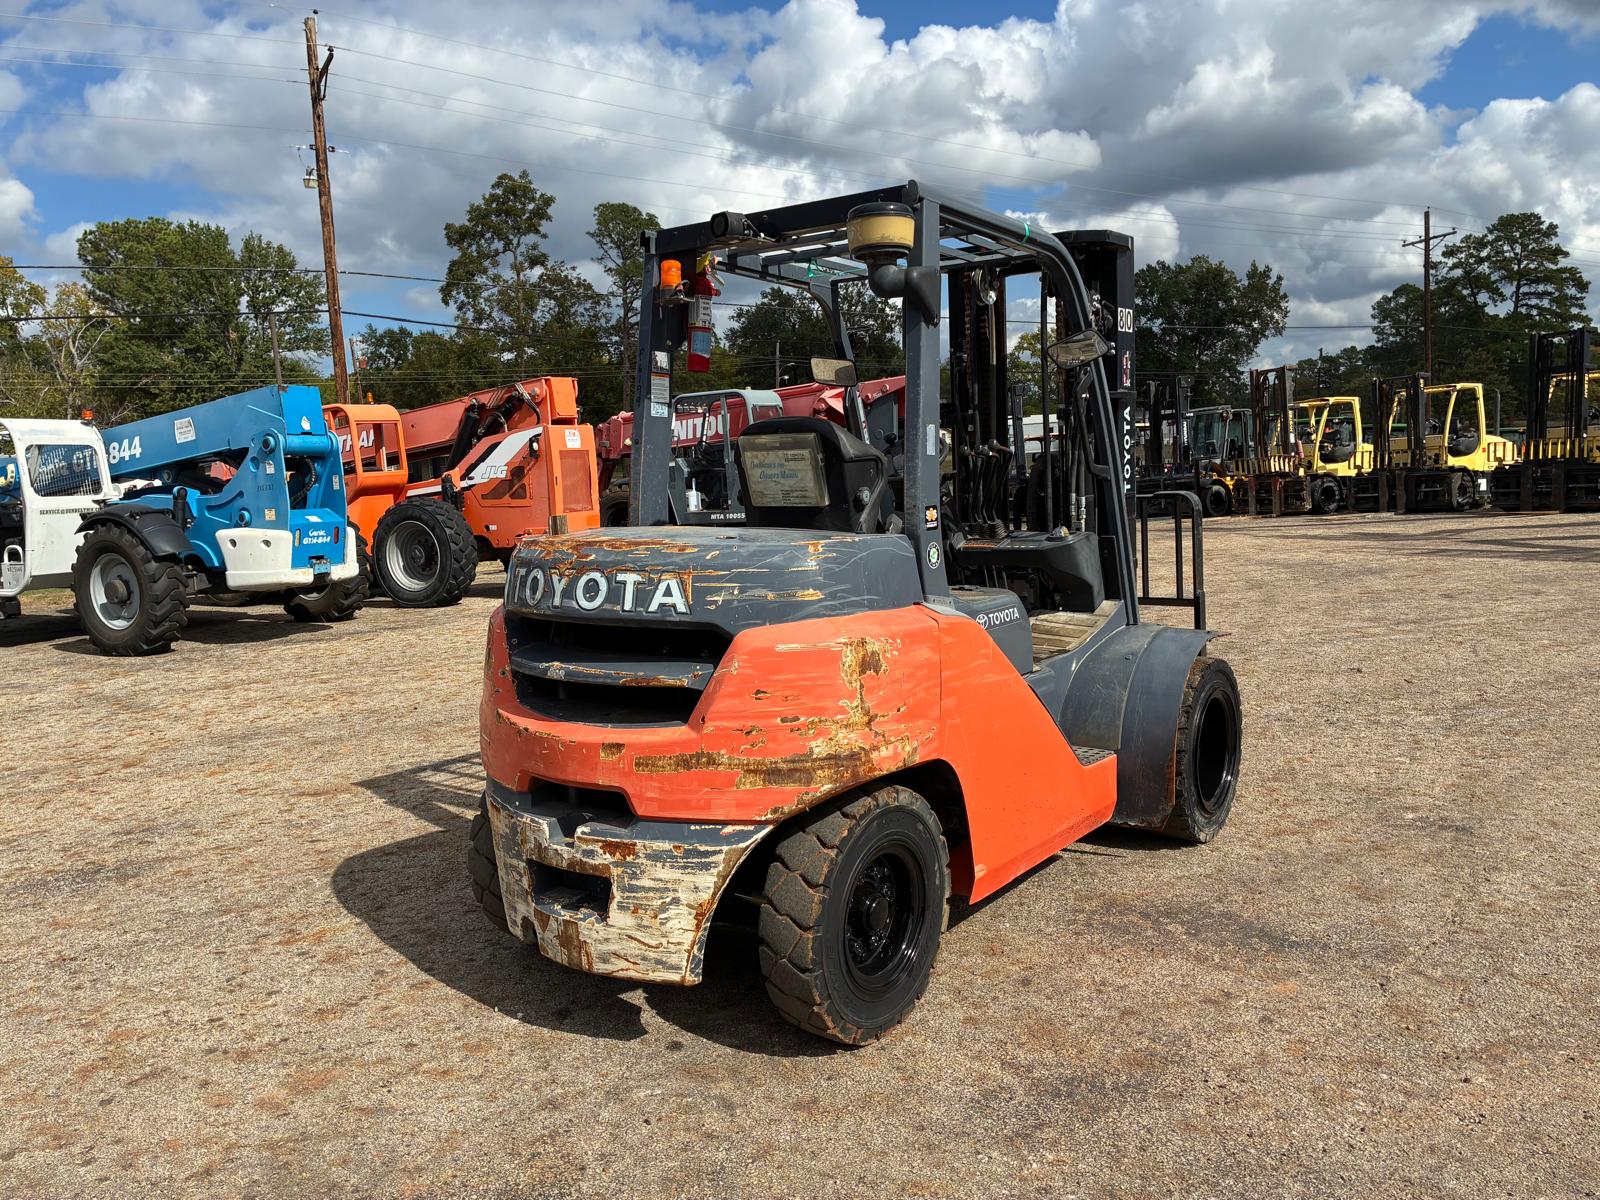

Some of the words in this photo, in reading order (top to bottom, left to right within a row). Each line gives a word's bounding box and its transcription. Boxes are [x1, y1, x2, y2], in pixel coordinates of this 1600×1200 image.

[1118, 308, 1133, 332] 80
[1123, 406, 1131, 493] TOYOTA
[481, 465, 508, 479] JLG
[514, 566, 690, 614] TOYOTA
[988, 608, 1019, 626] TOYOTA
